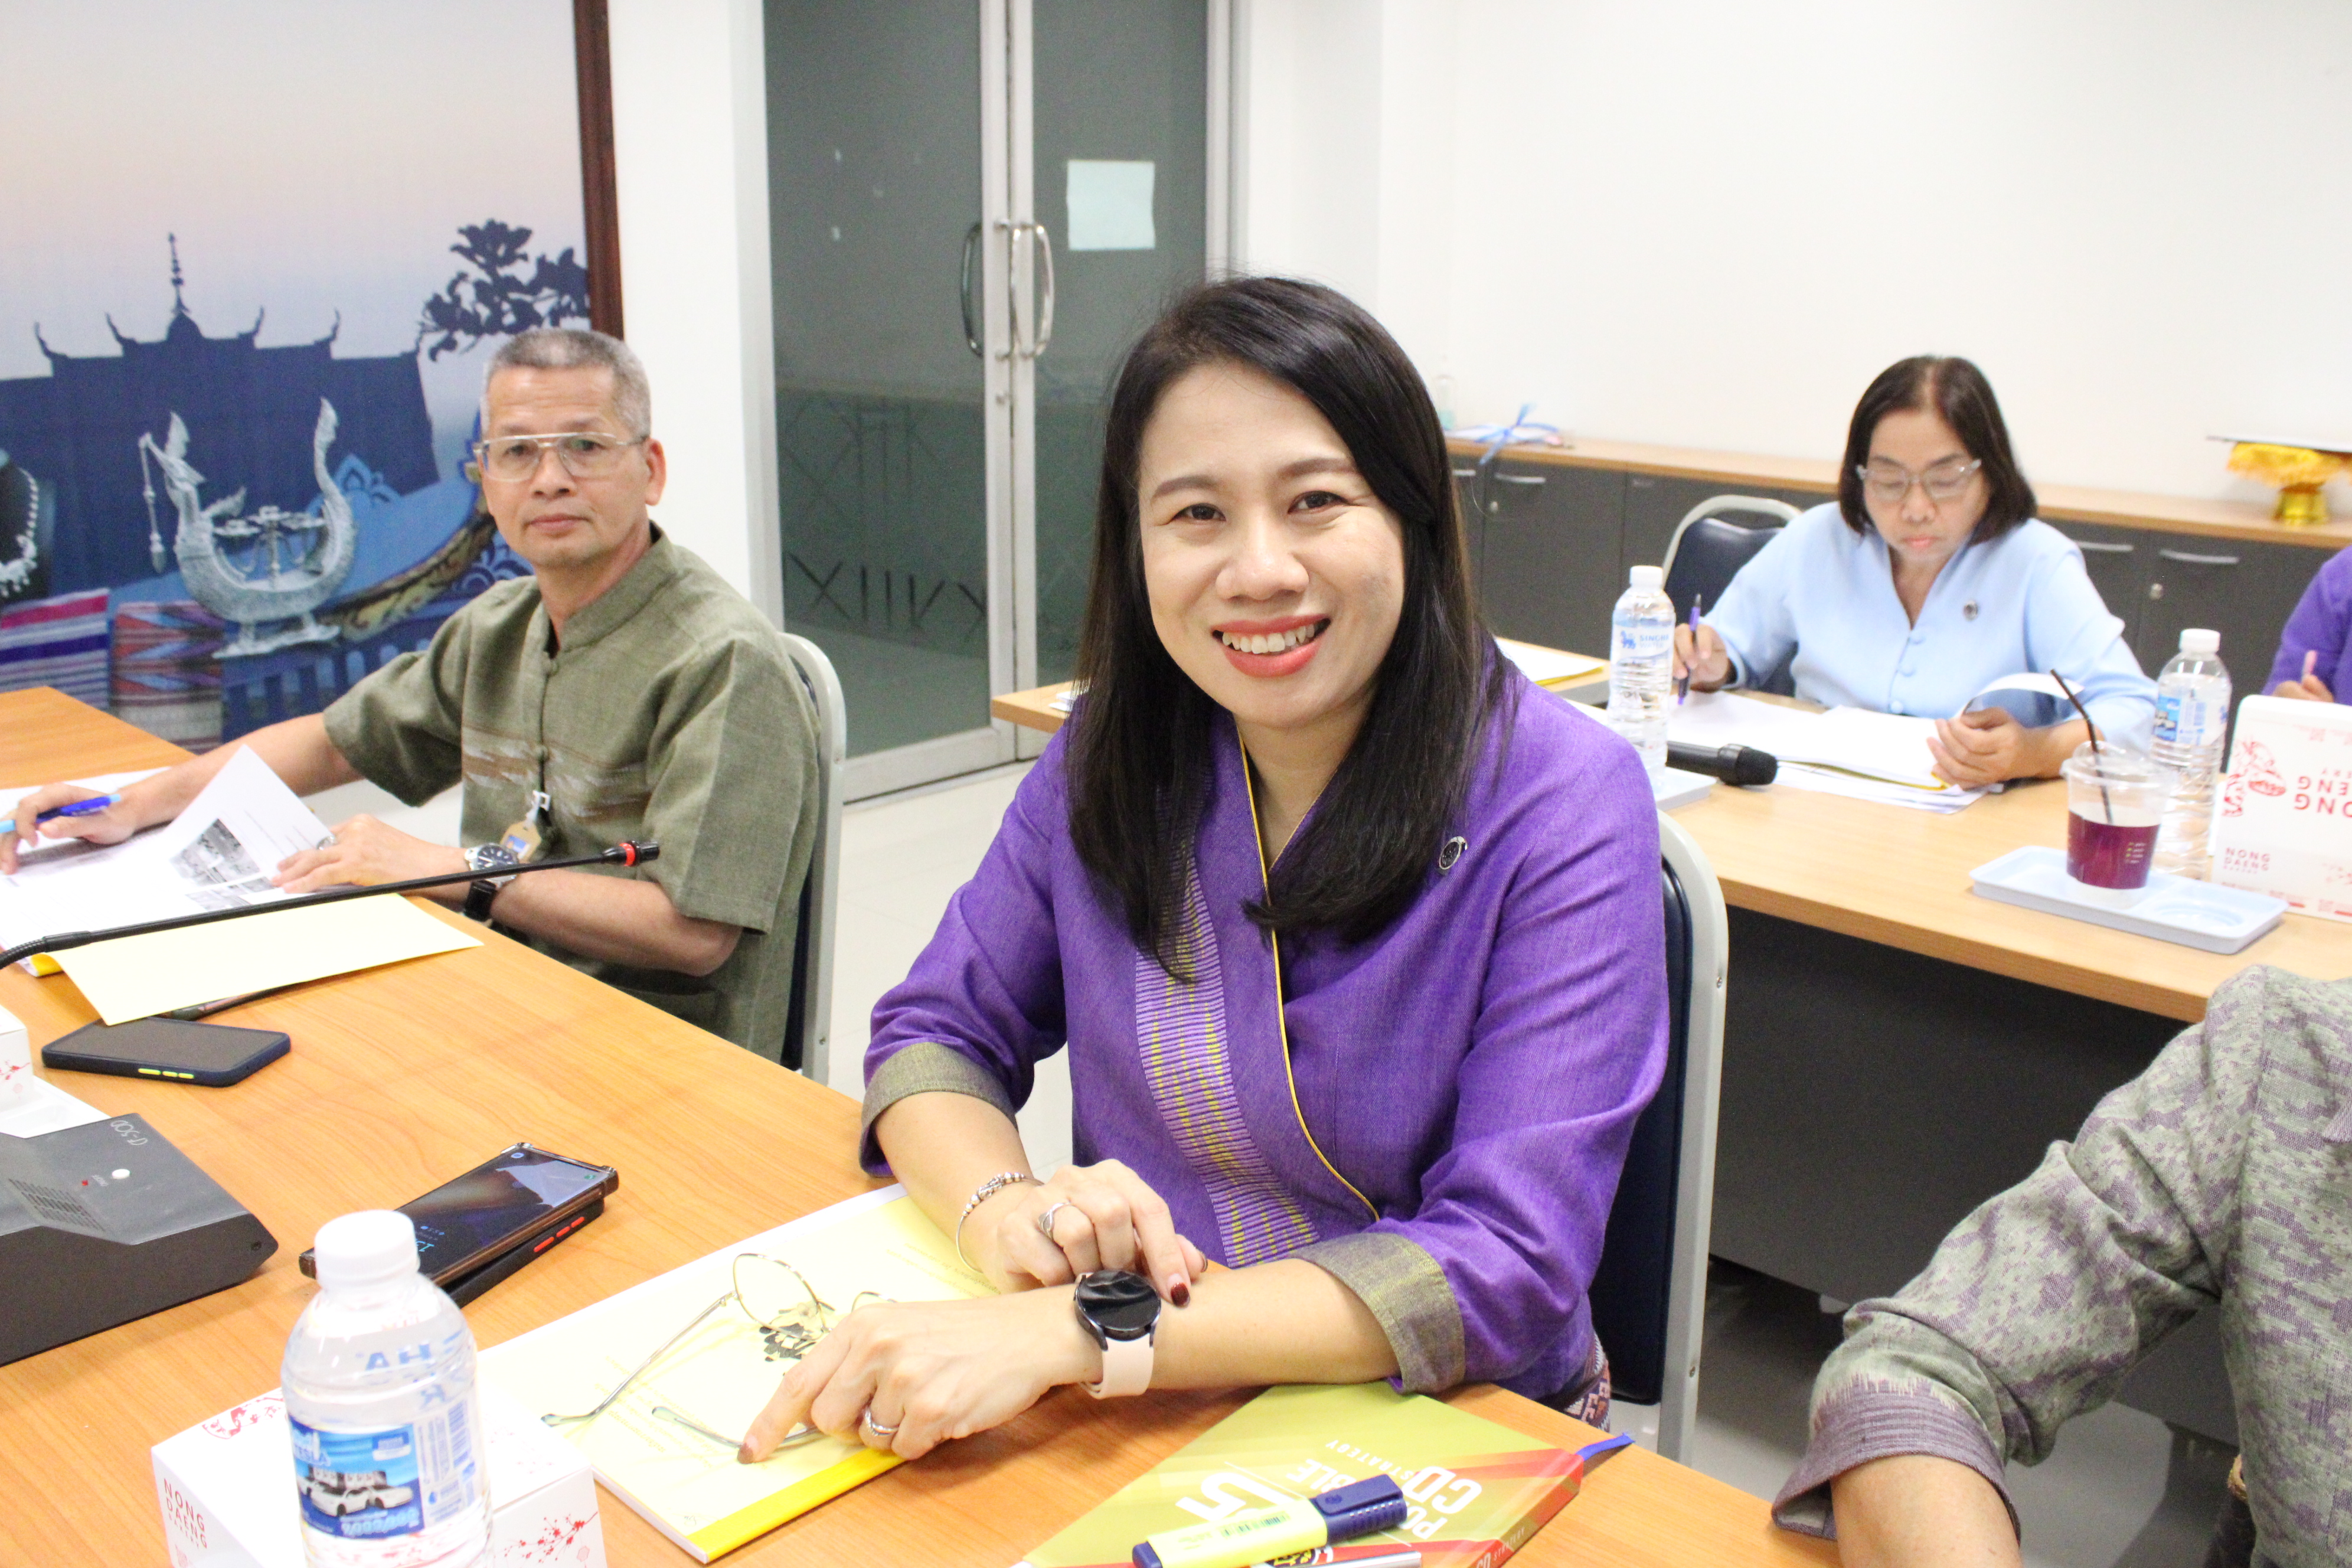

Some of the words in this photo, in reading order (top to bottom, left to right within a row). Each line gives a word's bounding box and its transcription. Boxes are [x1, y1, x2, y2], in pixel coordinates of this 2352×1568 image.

[2294, 793, 2352, 818] ONG
[2298, 775, 2349, 796] ENG
[2225, 847, 2271, 863] NONG
[1325, 1439, 1415, 1481] STRATEGY
[164, 1478, 205, 1533] NONG
[1401, 1465, 1483, 1515] CD
[166, 1497, 207, 1549] DAENG
